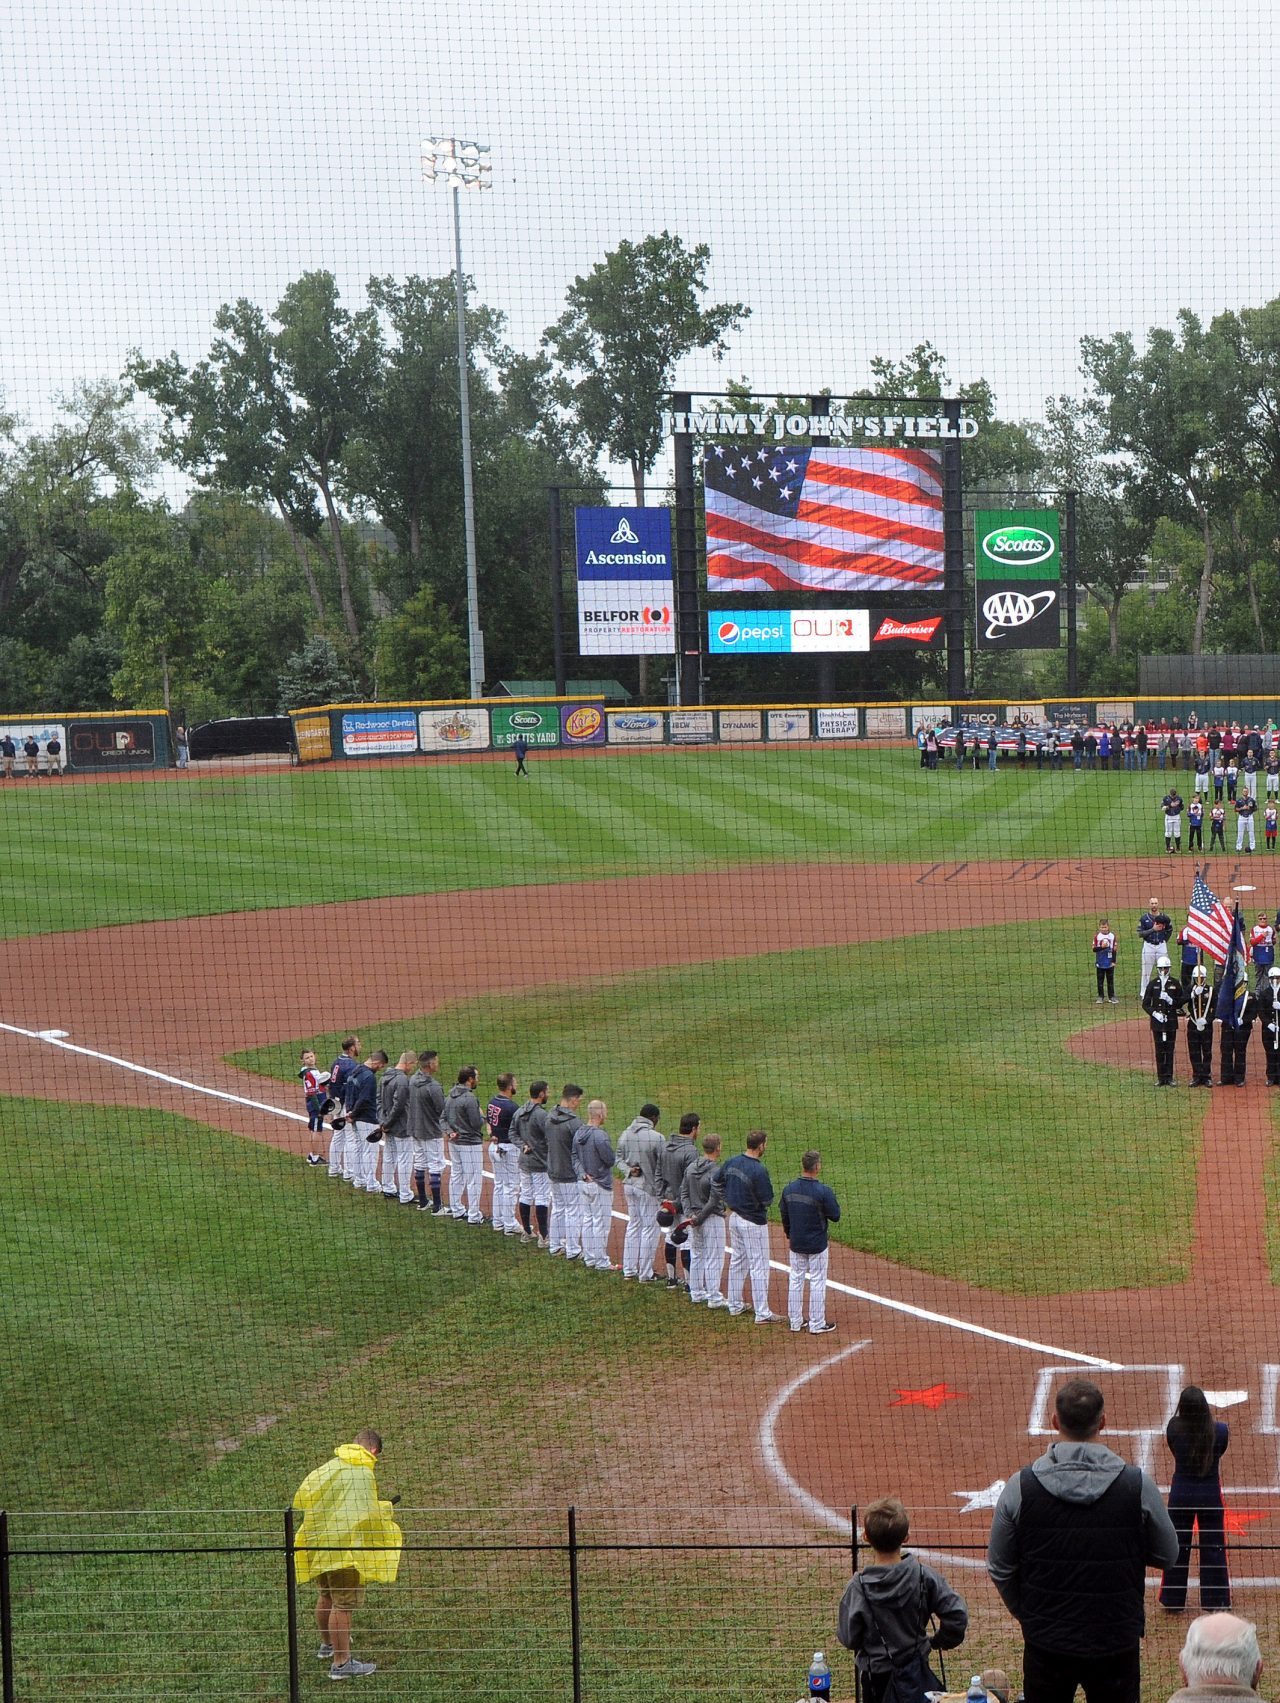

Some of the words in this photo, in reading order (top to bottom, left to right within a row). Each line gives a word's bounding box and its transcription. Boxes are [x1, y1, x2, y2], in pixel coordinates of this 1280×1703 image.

[660, 412, 768, 438] JIMMY
[773, 414, 880, 440] JOHN'S
[883, 416, 980, 438] FIELD
[585, 550, 667, 565] Ascension
[988, 594, 1031, 625] AAA
[583, 610, 640, 622] BELFOR
[741, 624, 785, 643] pepsi
[879, 622, 936, 635] Budweiser
[355, 720, 391, 730] Redwood
[391, 719, 416, 728] Dental
[513, 715, 538, 724] Scotts
[621, 717, 650, 729] Ford
[820, 720, 857, 728] PHYSICAL
[536, 732, 556, 743] YARD
[127, 748, 150, 756] UNION
